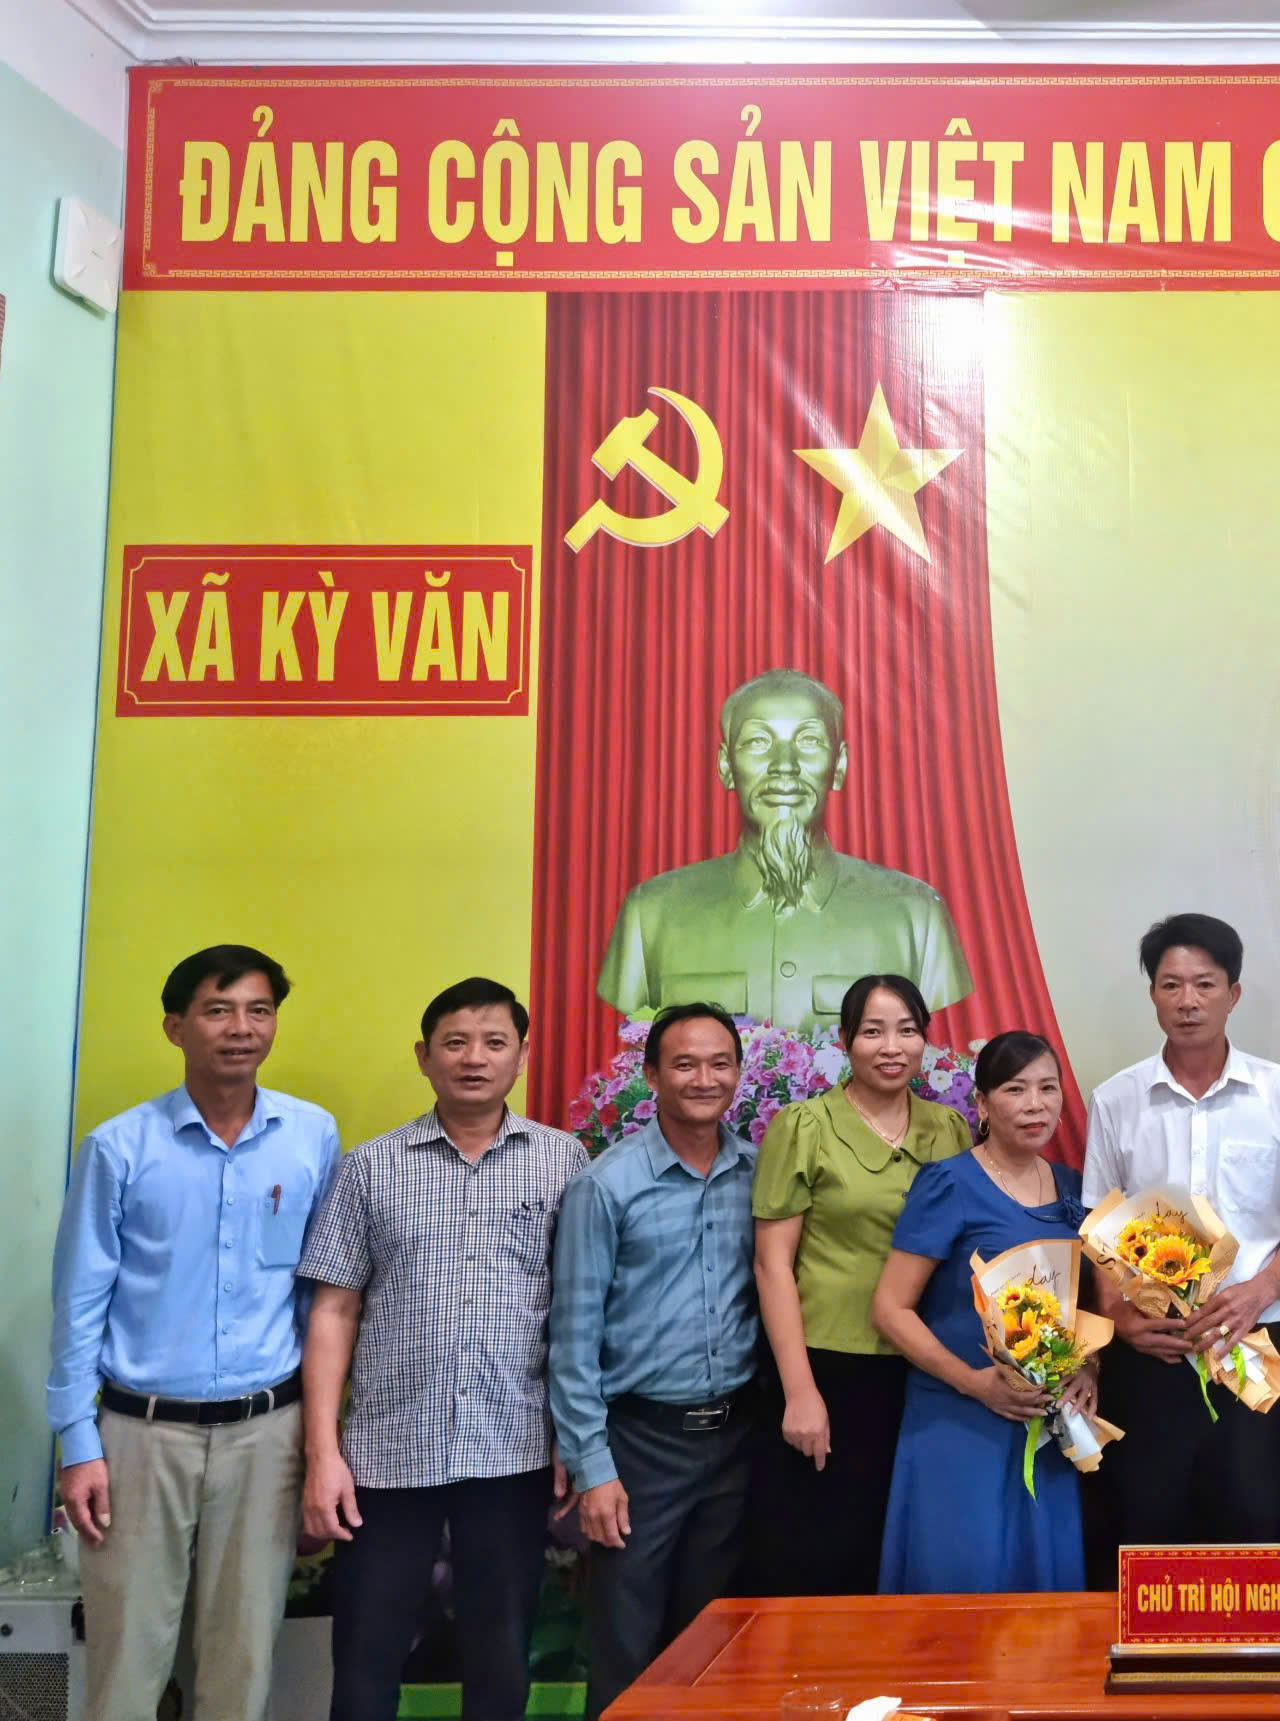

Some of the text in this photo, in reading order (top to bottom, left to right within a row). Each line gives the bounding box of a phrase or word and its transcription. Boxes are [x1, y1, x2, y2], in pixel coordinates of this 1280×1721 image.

[180, 104, 398, 244] ĐẢNG
[428, 118, 643, 267] CỘNG
[671, 103, 833, 244] SẢN
[859, 117, 1025, 265] VIỆT
[1051, 140, 1233, 244] NAM
[140, 569, 510, 682] XÃ KỲ VĂN
[1137, 1575, 1172, 1613] CHỦ
[1178, 1578, 1206, 1613] TRÌ
[1210, 1578, 1240, 1618] HỘI
